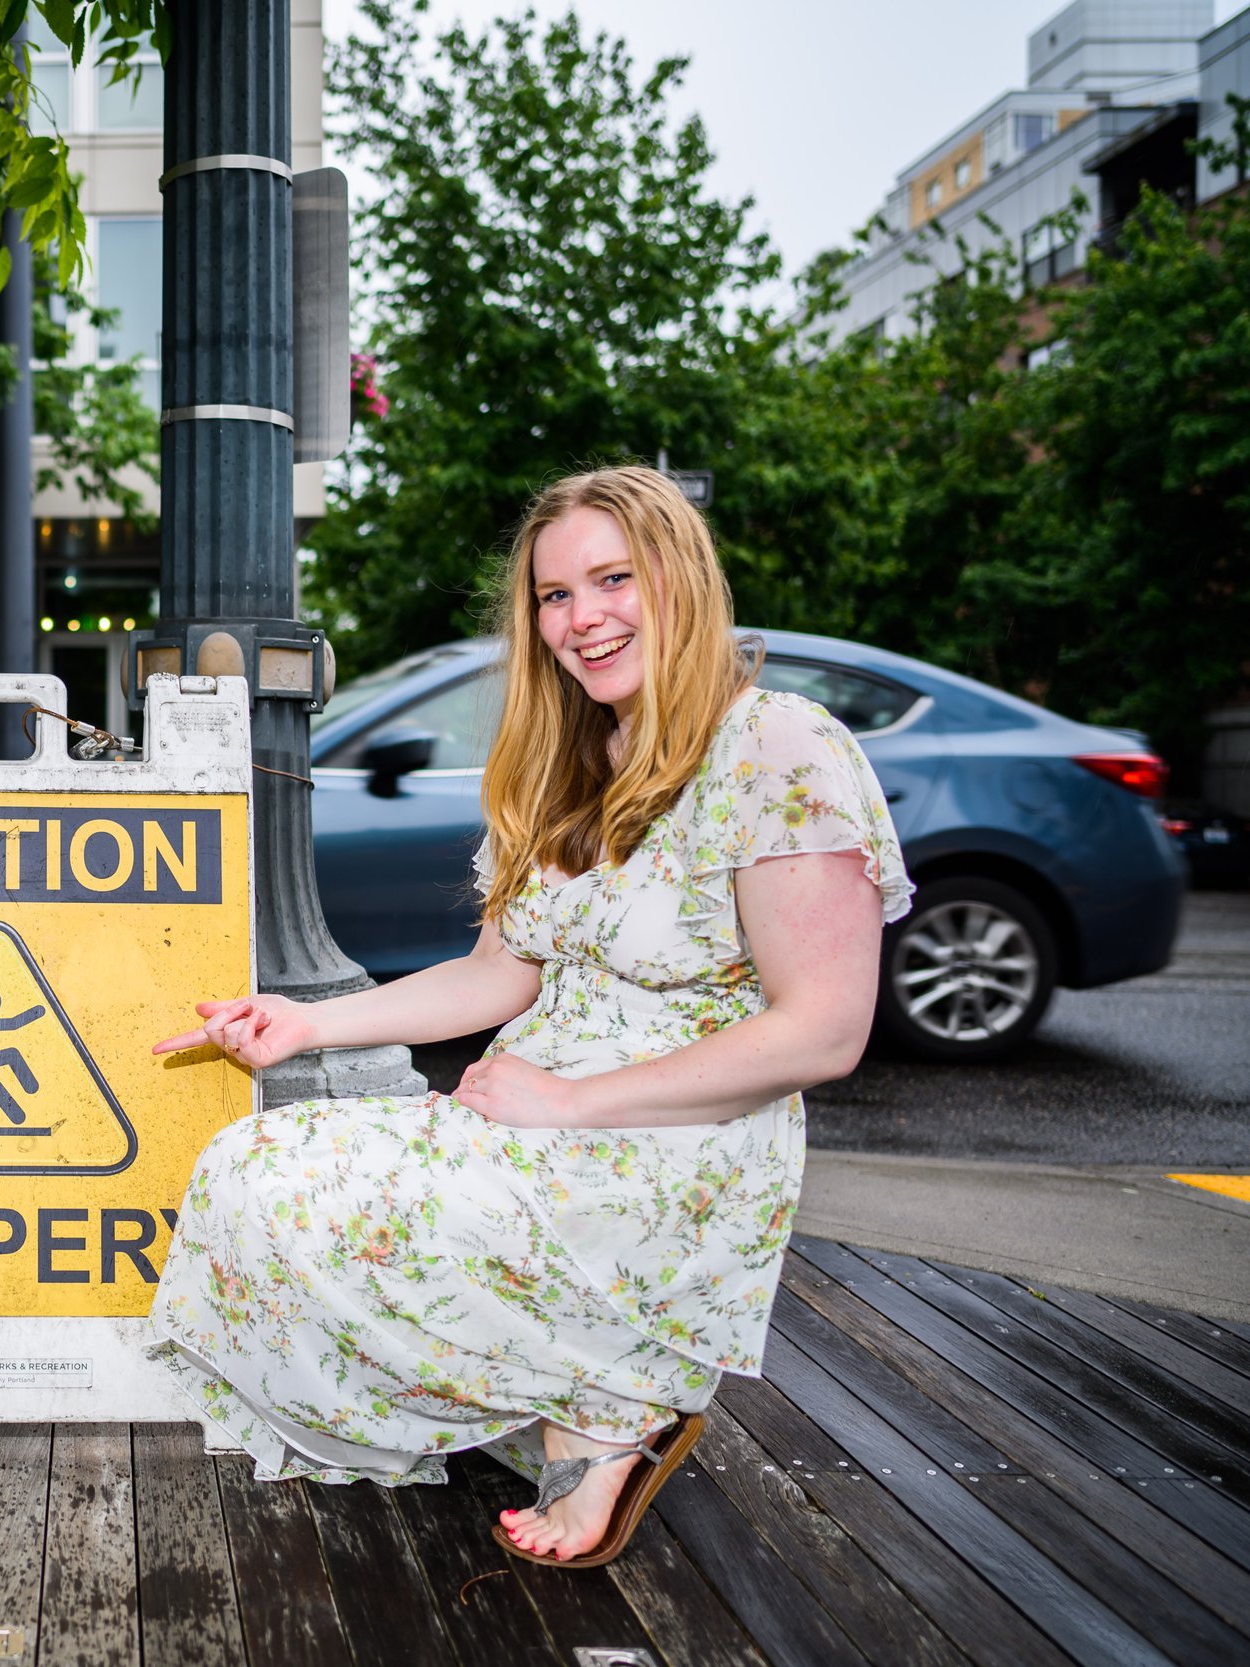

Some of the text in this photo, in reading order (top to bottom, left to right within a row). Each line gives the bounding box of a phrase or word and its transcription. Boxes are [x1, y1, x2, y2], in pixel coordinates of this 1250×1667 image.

[20, 1362, 26, 1371] &
[28, 1362, 88, 1371] RECREATION
[8, 1375, 36, 1384] Portland
